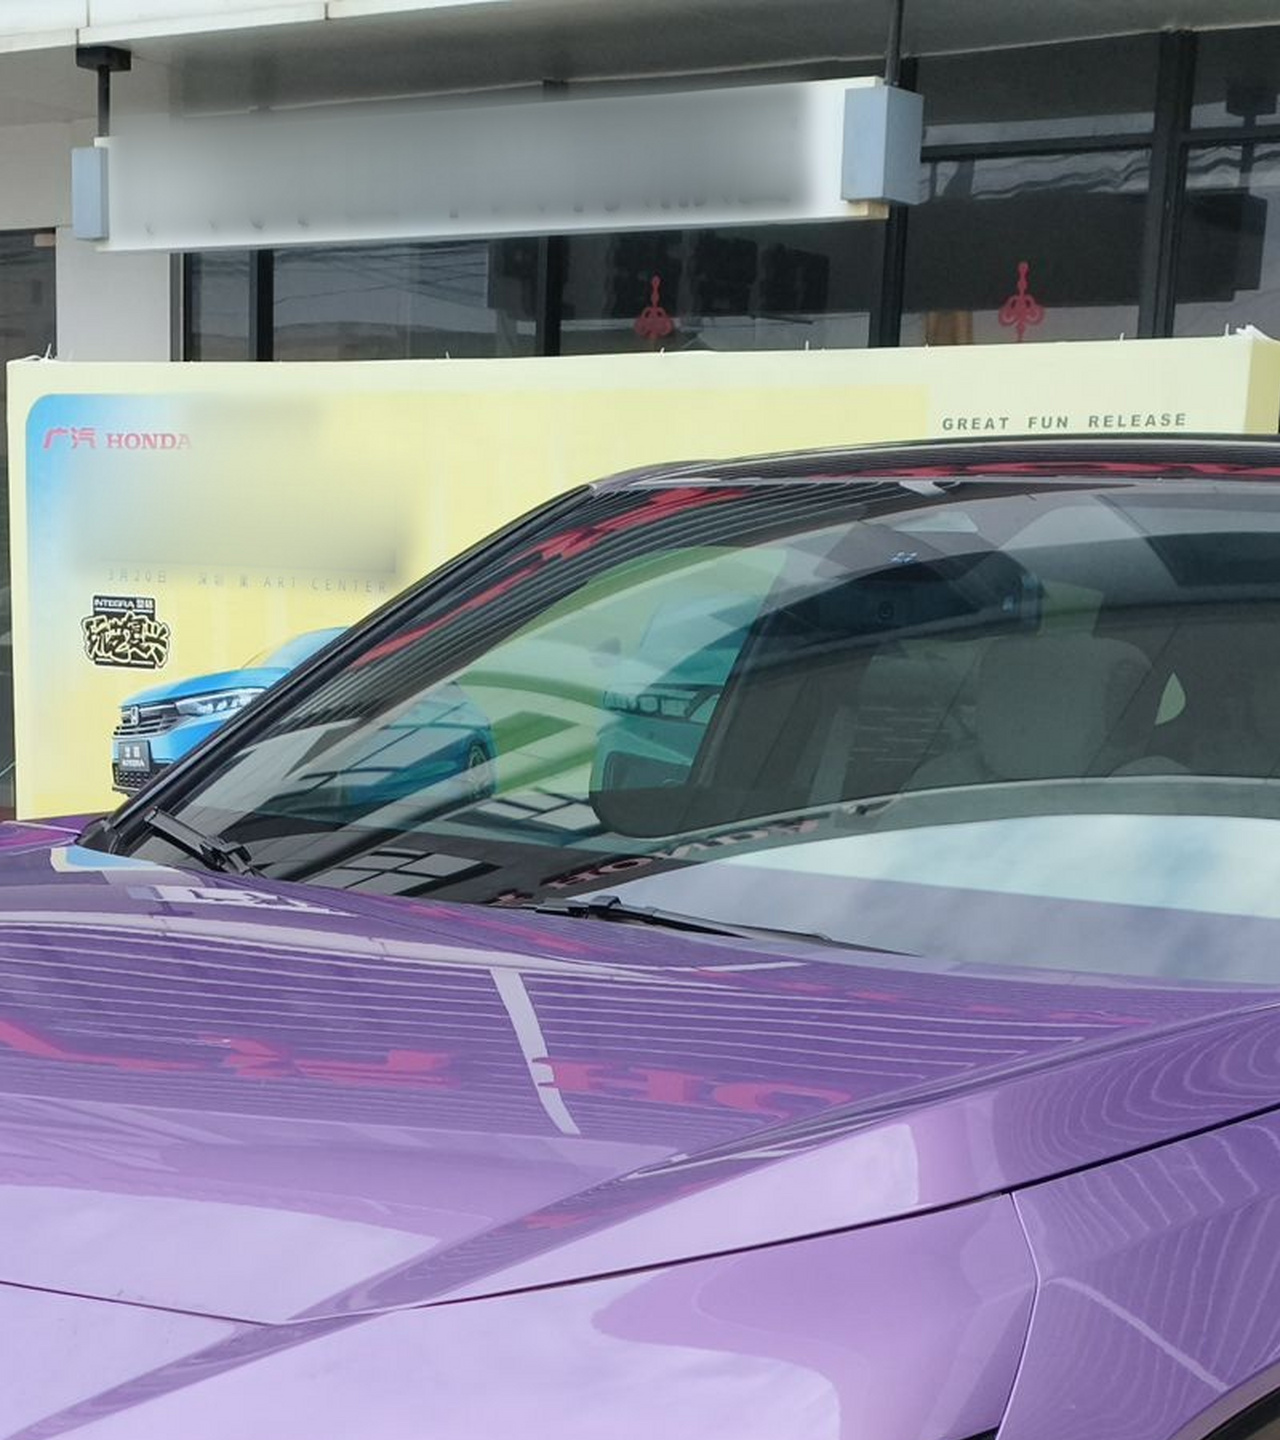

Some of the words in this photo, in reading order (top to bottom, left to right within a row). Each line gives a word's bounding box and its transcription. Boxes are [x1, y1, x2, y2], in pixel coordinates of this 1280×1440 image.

[942, 416, 1010, 431] GREAT
[1028, 415, 1069, 430] FUN
[1088, 412, 1187, 429] RELEASE
[43, 425, 97, 450] 广汽
[105, 432, 192, 450] HONDA
